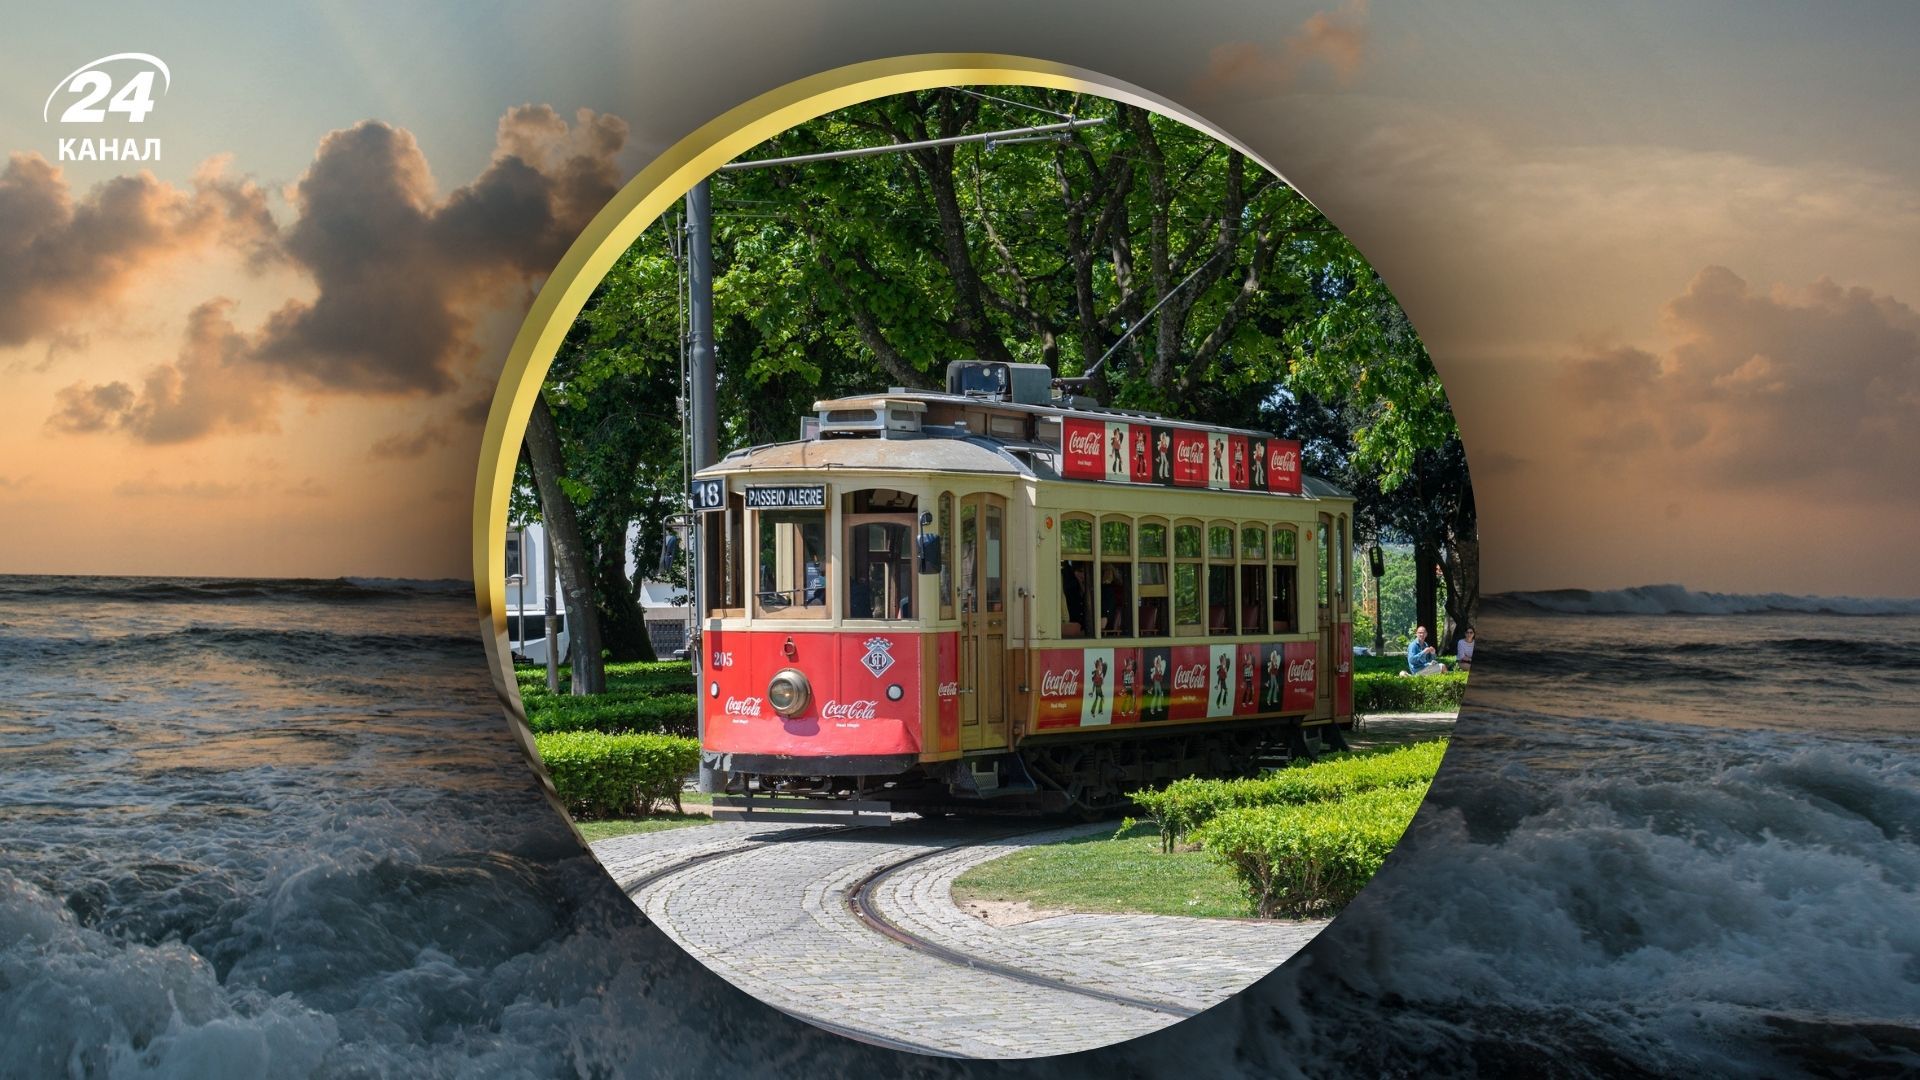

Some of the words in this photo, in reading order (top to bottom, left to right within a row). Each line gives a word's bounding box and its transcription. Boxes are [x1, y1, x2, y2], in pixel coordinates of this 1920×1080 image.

[699, 482, 719, 507] 18
[748, 489, 785, 506] PASSEIO
[787, 488, 822, 505] ALEGRE
[713, 651, 733, 667] 205
